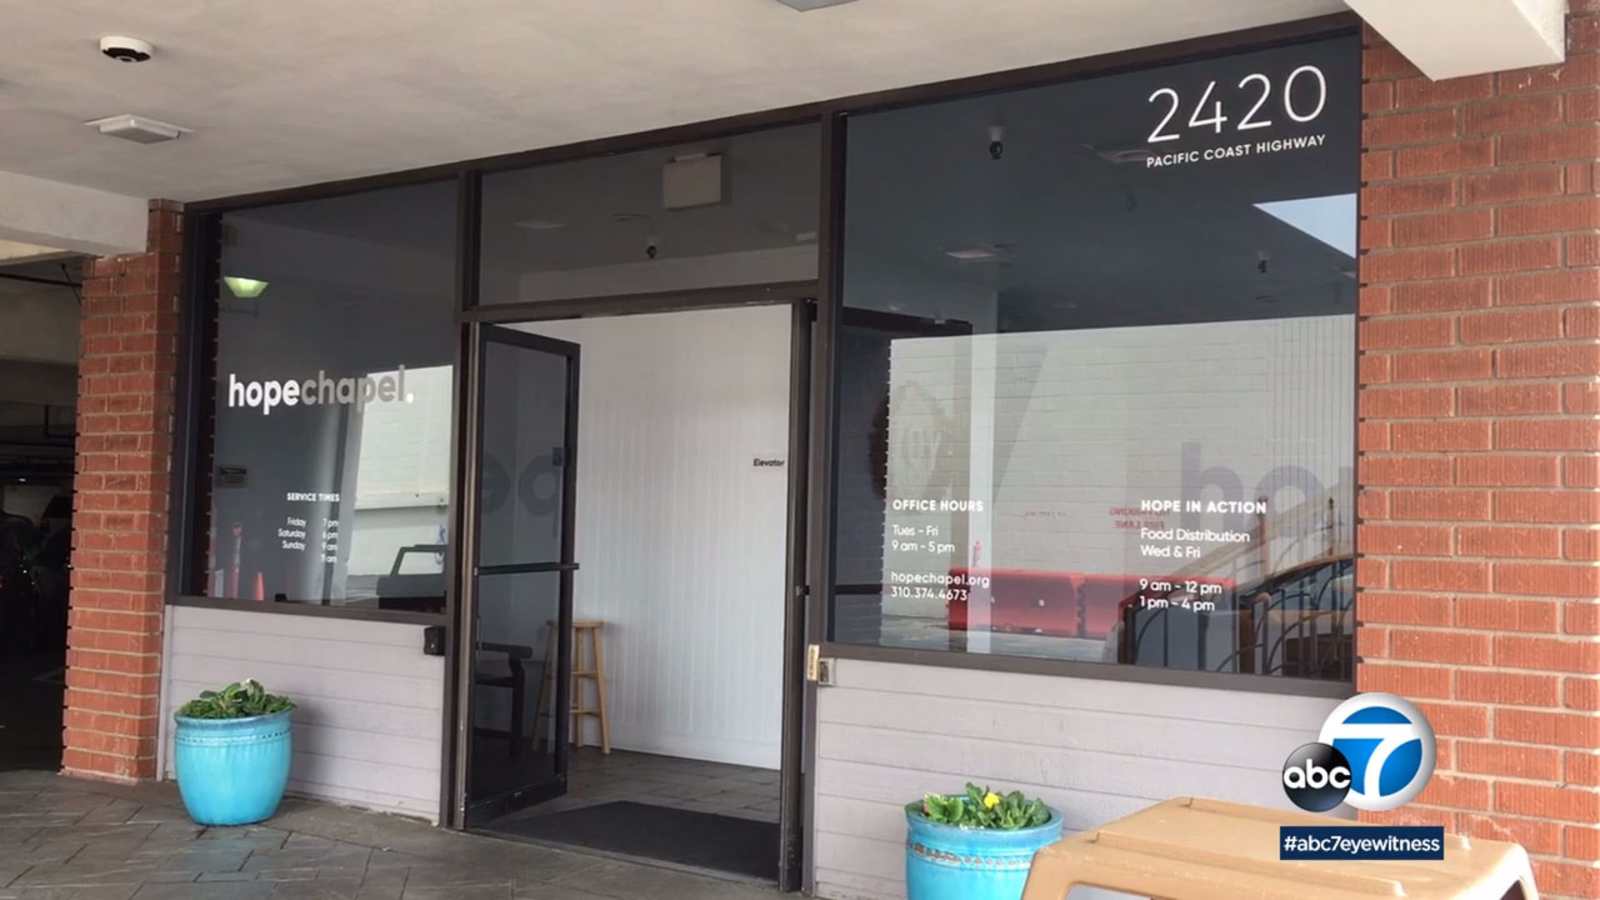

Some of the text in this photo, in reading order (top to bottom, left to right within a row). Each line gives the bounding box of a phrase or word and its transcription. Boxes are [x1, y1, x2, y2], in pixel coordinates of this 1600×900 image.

[1147, 65, 1327, 143] 2420
[1146, 134, 1326, 168] PACIFIC COAST HIGHWAY
[753, 458, 785, 468] Elevator
[287, 492, 340, 502] SERVICE TIMES
[892, 500, 984, 512] OFFICE HOURS
[1140, 500, 1267, 514] HOPE IN ACTION
[287, 516, 307, 529] Friday
[278, 528, 307, 540] Saturday
[892, 525, 915, 536] Tues
[926, 525, 939, 536] Fri
[1140, 528, 1250, 543] Food Distribution
[282, 540, 306, 552] Sunday
[892, 540, 899, 551] 9
[900, 543, 917, 552] am
[929, 541, 936, 552] 5
[937, 544, 956, 554] pm
[1140, 545, 1201, 558] Wed & Fri
[891, 571, 990, 589] hopechapel.org
[891, 586, 968, 601] 310.374.4673
[1139, 578, 1148, 591] 9
[1150, 582, 1172, 592] am
[1185, 581, 1197, 593] 12
[1200, 584, 1223, 597] pm
[1140, 596, 1146, 608] 1
[1147, 599, 1169, 611] pm
[1181, 598, 1191, 610] 4
[1193, 601, 1215, 614] pm
